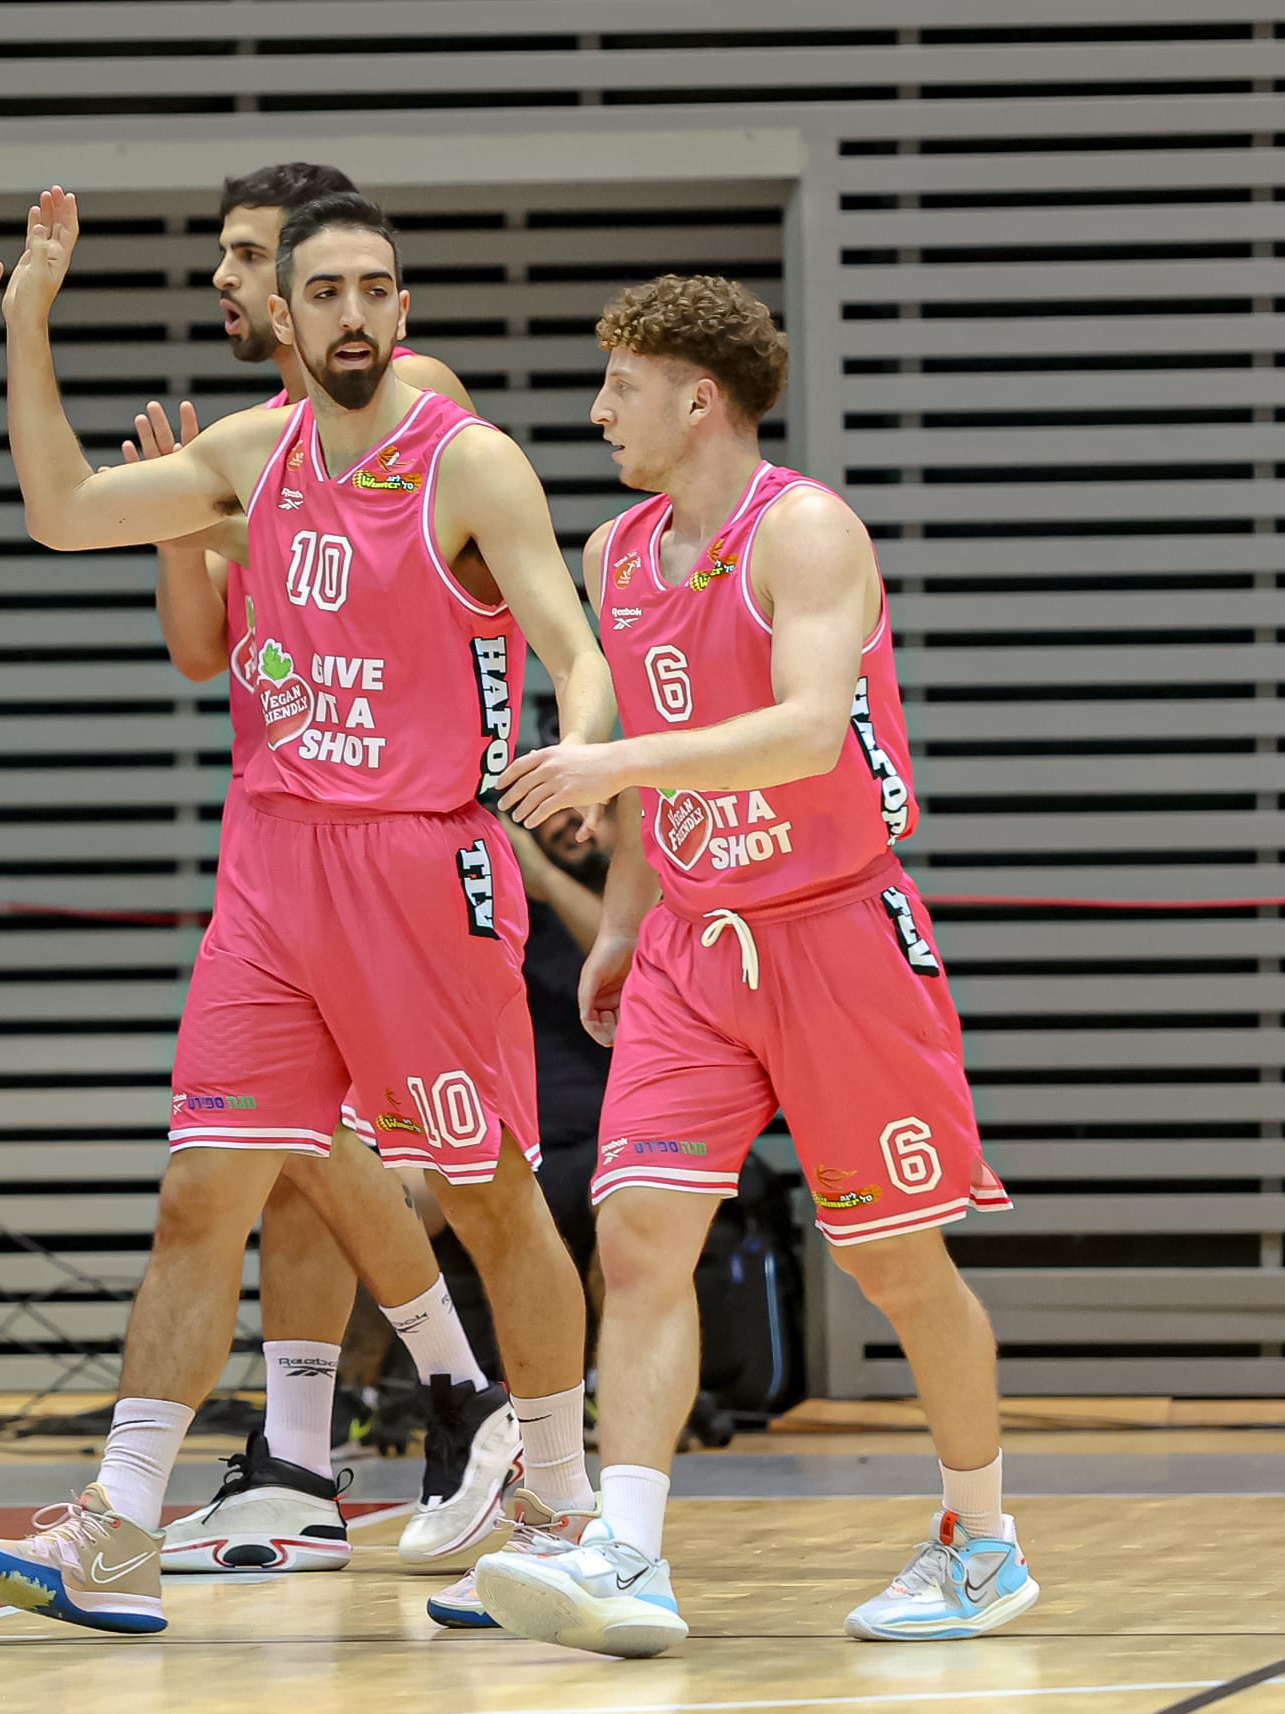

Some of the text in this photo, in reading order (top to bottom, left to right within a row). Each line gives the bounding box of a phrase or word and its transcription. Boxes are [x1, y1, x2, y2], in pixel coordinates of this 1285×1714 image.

[286, 530, 354, 612] 10
[612, 608, 642, 617] Reebok
[311, 653, 385, 691] GIVE
[644, 645, 694, 723] 6
[261, 685, 302, 712] VEGAN
[264, 696, 309, 727] RIENDLY
[316, 691, 376, 729] IT A
[298, 729, 386, 769] SHOT
[667, 798, 694, 829] VEGAN
[708, 790, 778, 829] IT A
[709, 821, 793, 870] SHOT
[406, 1070, 488, 1148] 10
[879, 1116, 944, 1195] 6
